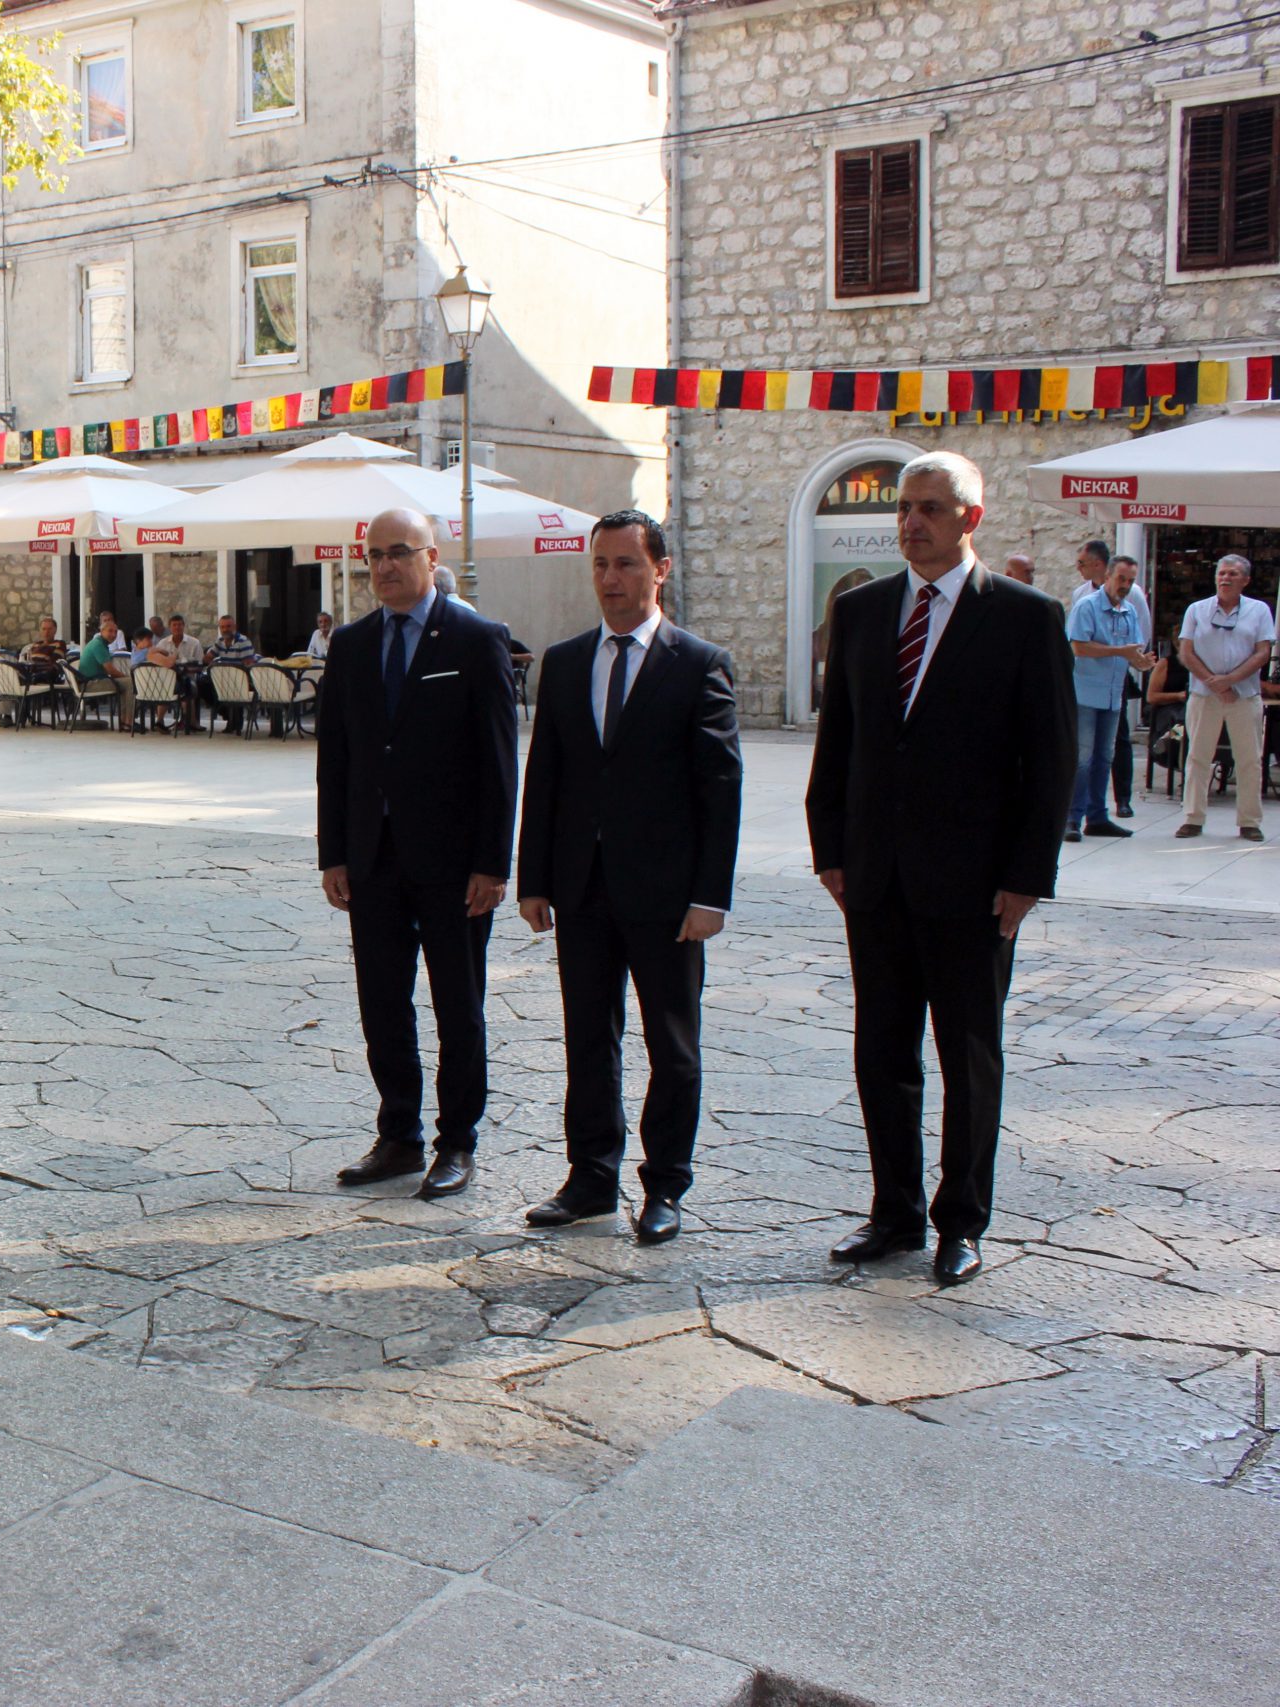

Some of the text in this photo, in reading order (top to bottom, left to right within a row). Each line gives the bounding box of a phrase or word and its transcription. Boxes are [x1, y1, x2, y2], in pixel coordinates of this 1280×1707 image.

[845, 480, 898, 504] Dio
[1070, 480, 1130, 495] NEKTAR
[41, 523, 71, 534] NEKTAR
[141, 530, 180, 542] NEKTAR
[540, 540, 580, 550] NEKTAR
[320, 548, 358, 556] NEKR
